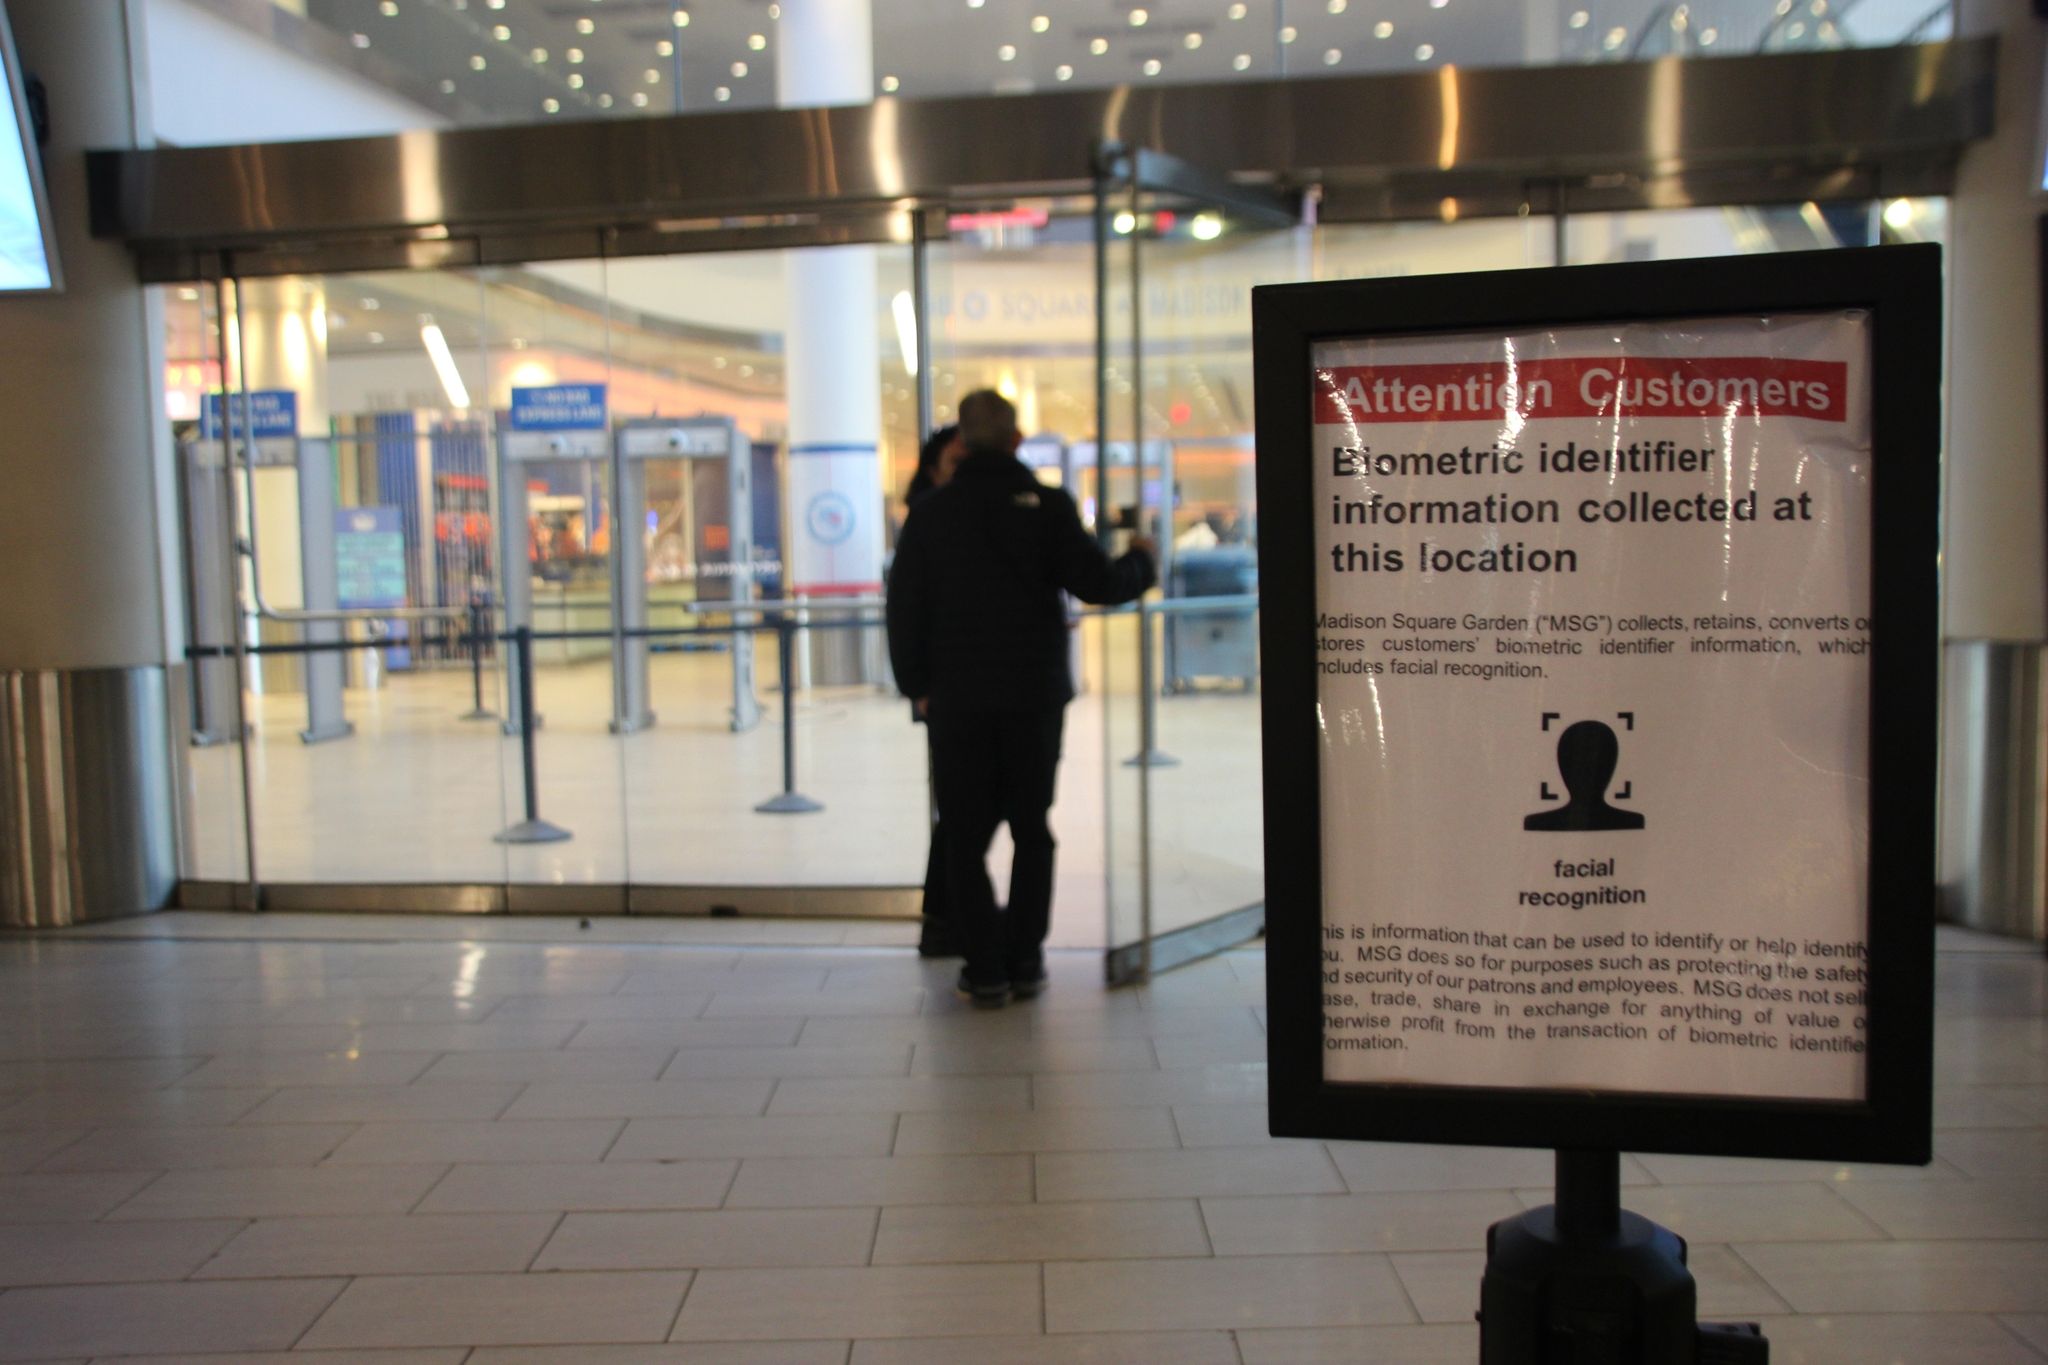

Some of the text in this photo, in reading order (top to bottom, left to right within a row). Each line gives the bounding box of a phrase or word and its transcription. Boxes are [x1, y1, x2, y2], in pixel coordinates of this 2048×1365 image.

[1340, 368, 1831, 413] Attention Customers
[1333, 441, 1715, 476] Biometric identifier
[1333, 491, 1812, 524] information collected at
[1332, 542, 1578, 573] this location
[1316, 613, 1386, 629] Madison
[1393, 613, 1456, 632] Square
[1463, 614, 1528, 631] Garden
[1618, 615, 1688, 631] collects,
[1693, 615, 1762, 631] retains,
[1769, 615, 1849, 631] converts
[1496, 639, 1582, 654] biometric
[1600, 638, 1674, 655] identifier
[1691, 637, 1801, 654] information,
[1819, 639, 1871, 654] which
[1318, 660, 1548, 680] ncludes facial recognition.
[1554, 859, 1615, 878] facial
[1519, 886, 1646, 910] recognition
[1322, 924, 1344, 939] his
[1351, 924, 1365, 939] is
[1372, 924, 1469, 944] information
[1474, 931, 1507, 948] that
[1514, 936, 1546, 949] can
[1554, 935, 1575, 949] be
[1583, 932, 1624, 948] used
[1632, 933, 1648, 947] to
[1655, 931, 1724, 953] identify
[1730, 939, 1749, 950] or
[1757, 937, 1797, 956] help
[1322, 951, 1344, 962] ou.
[1358, 946, 1401, 961] MSG
[1408, 948, 1449, 965] does
[1455, 955, 1475, 967] so
[1481, 954, 1505, 970] for
[1512, 958, 1593, 975] purposes
[1600, 955, 1642, 970] such
[1649, 958, 1670, 970] as
[1677, 958, 1772, 981] protecting
[1778, 962, 1808, 979] the
[1322, 969, 1339, 983] nd
[1345, 968, 1412, 986] security
[1417, 970, 1433, 984] of
[1437, 975, 1464, 988] our
[1468, 978, 1536, 994] patrons
[1541, 978, 1573, 993] and
[1578, 977, 1684, 995] employees.
[1694, 980, 1742, 997] MSG
[1747, 984, 1792, 1001] does
[1799, 989, 1829, 1003] not
[1324, 992, 1866, 1029] ase, trade, share in exchange for anything of value o
[1323, 1012, 1866, 1053] herwise profit from the transaction of biometric identifie
[1324, 1034, 1408, 1050] ormation.
